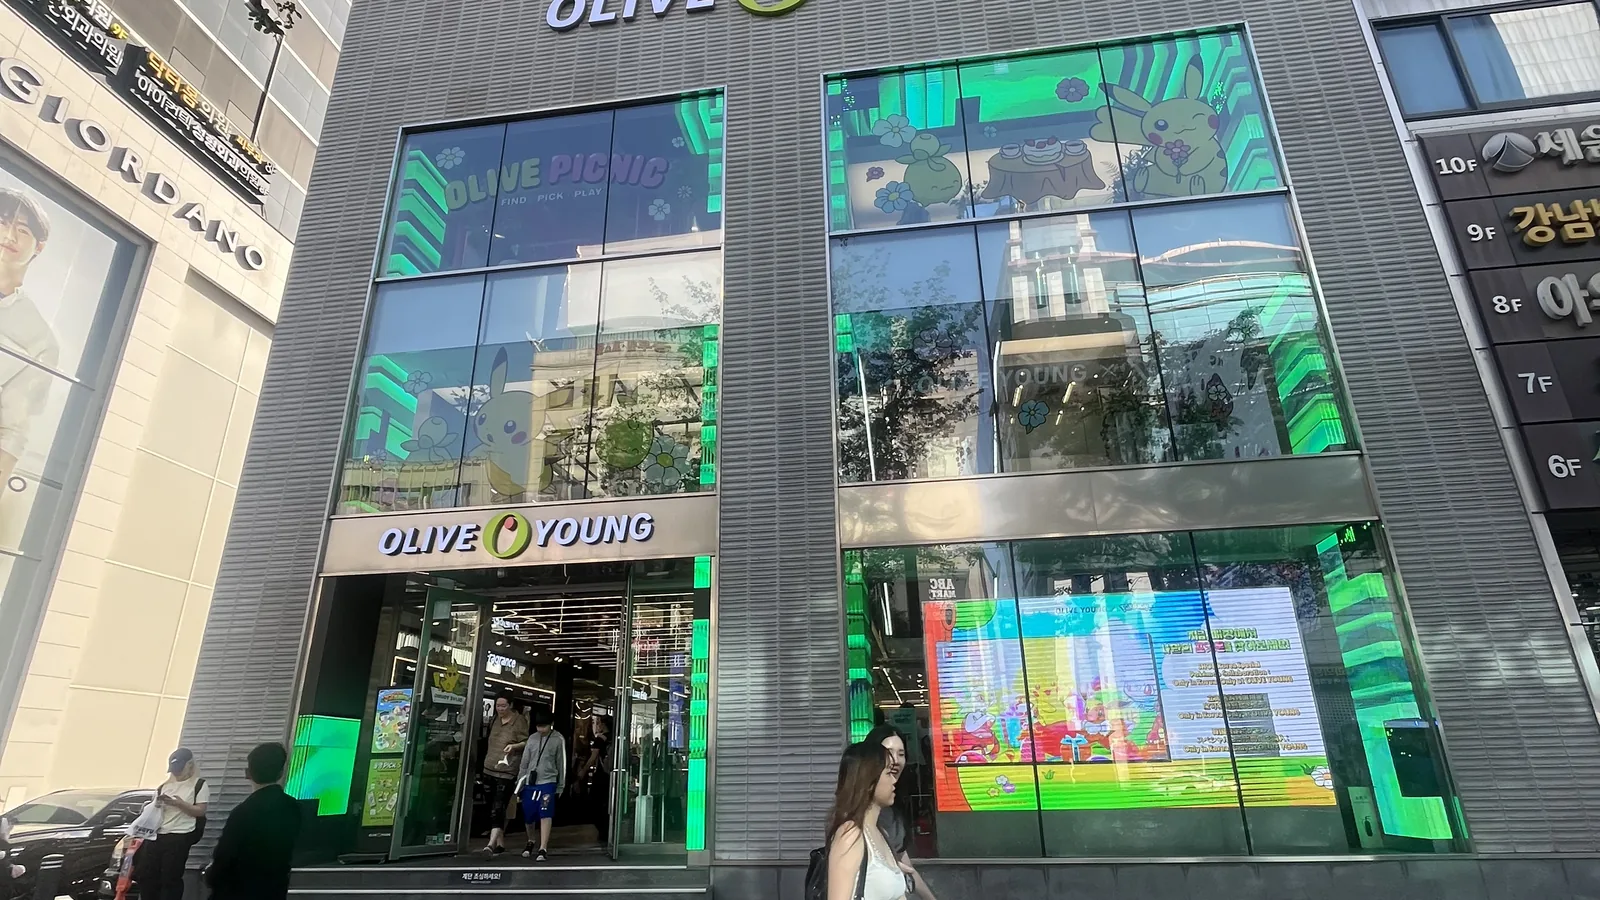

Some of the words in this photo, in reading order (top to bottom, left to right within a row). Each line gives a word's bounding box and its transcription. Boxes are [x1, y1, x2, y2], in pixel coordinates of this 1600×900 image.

[1, 57, 266, 271] GIORDANO
[1436, 156, 1477, 175] 10F
[445, 158, 541, 211] OLIVE
[549, 152, 670, 188] PICNIC
[501, 197, 527, 206] FIND
[537, 192, 564, 202] PICK
[574, 188, 602, 198] PLAY
[1466, 223, 1496, 242] 9F
[1509, 199, 1600, 246] 강남
[1492, 295, 1522, 314] 8F
[1001, 363, 1087, 386] YOUNG
[1518, 372, 1553, 393] 7F
[1548, 455, 1582, 478] 6F
[378, 523, 478, 556] OLIVE
[535, 512, 653, 546] YOUNG
[487, 653, 516, 669] ragrance
